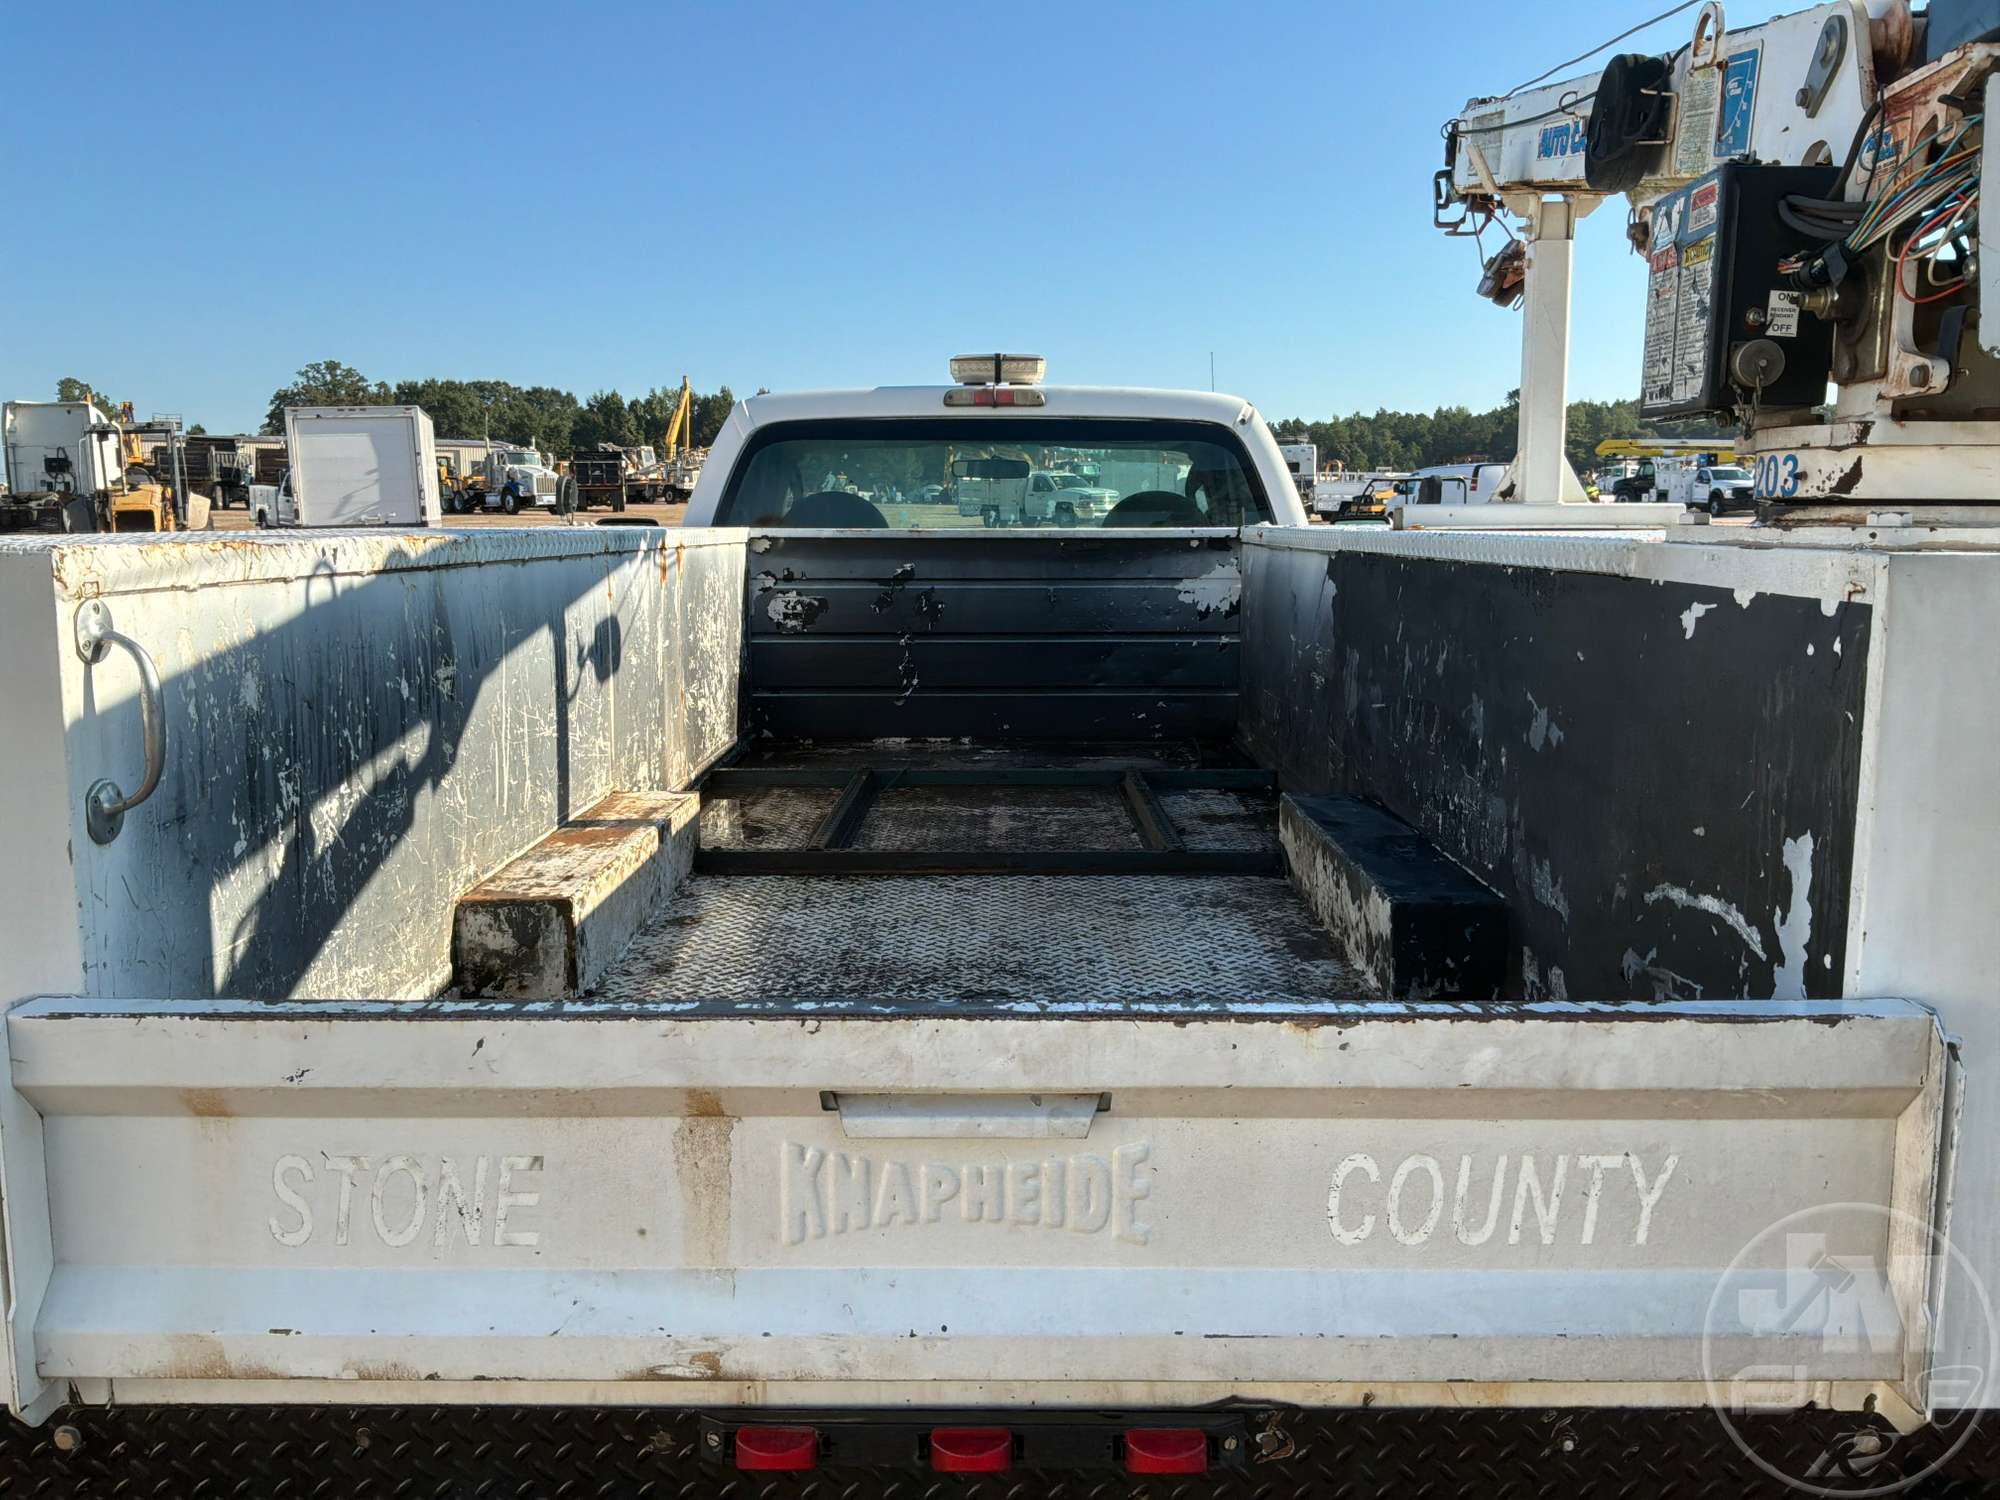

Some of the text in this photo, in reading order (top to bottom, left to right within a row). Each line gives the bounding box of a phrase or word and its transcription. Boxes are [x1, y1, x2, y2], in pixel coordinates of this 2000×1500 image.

[1772, 324, 1792, 332] OFF
[1756, 454, 1798, 497] 203
[268, 1154, 544, 1248] STONE
[782, 1140, 1151, 1246] KNAPHEIDE
[1327, 1152, 1679, 1245] COUNTY
